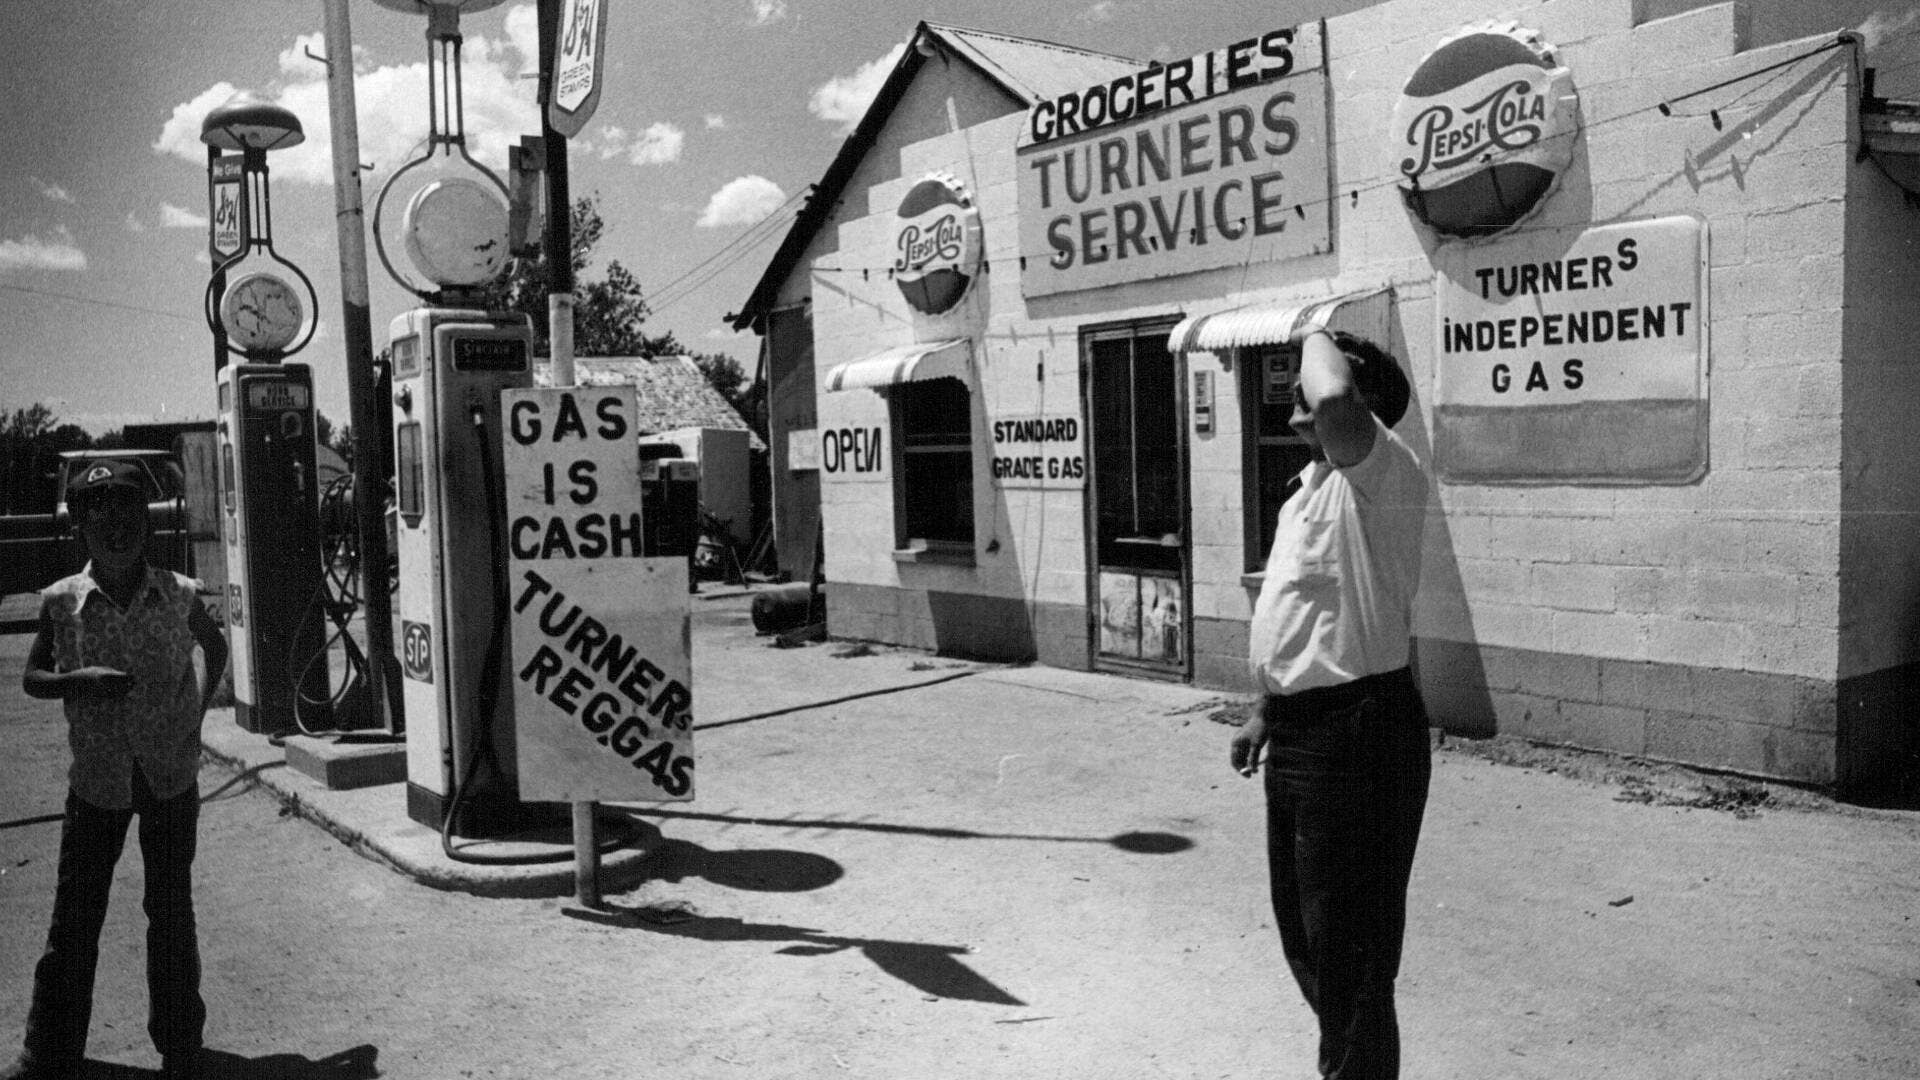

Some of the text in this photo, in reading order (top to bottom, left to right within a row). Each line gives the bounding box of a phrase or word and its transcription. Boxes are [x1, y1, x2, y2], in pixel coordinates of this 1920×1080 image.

[1031, 28, 1295, 145] GROCERIES
[1030, 91, 1300, 209] TURNERS
[1046, 170, 1288, 271] SERVICE
[1475, 238, 1639, 299] TURNERS
[1491, 359, 1584, 394] GAS
[510, 394, 626, 446] GAS
[994, 418, 1078, 443] STANDARD
[823, 427, 882, 473] OPEN
[993, 456, 1084, 479] GRADE GAS
[544, 460, 598, 505] IS
[510, 512, 642, 560] CASH
[407, 628, 428, 668] STP
